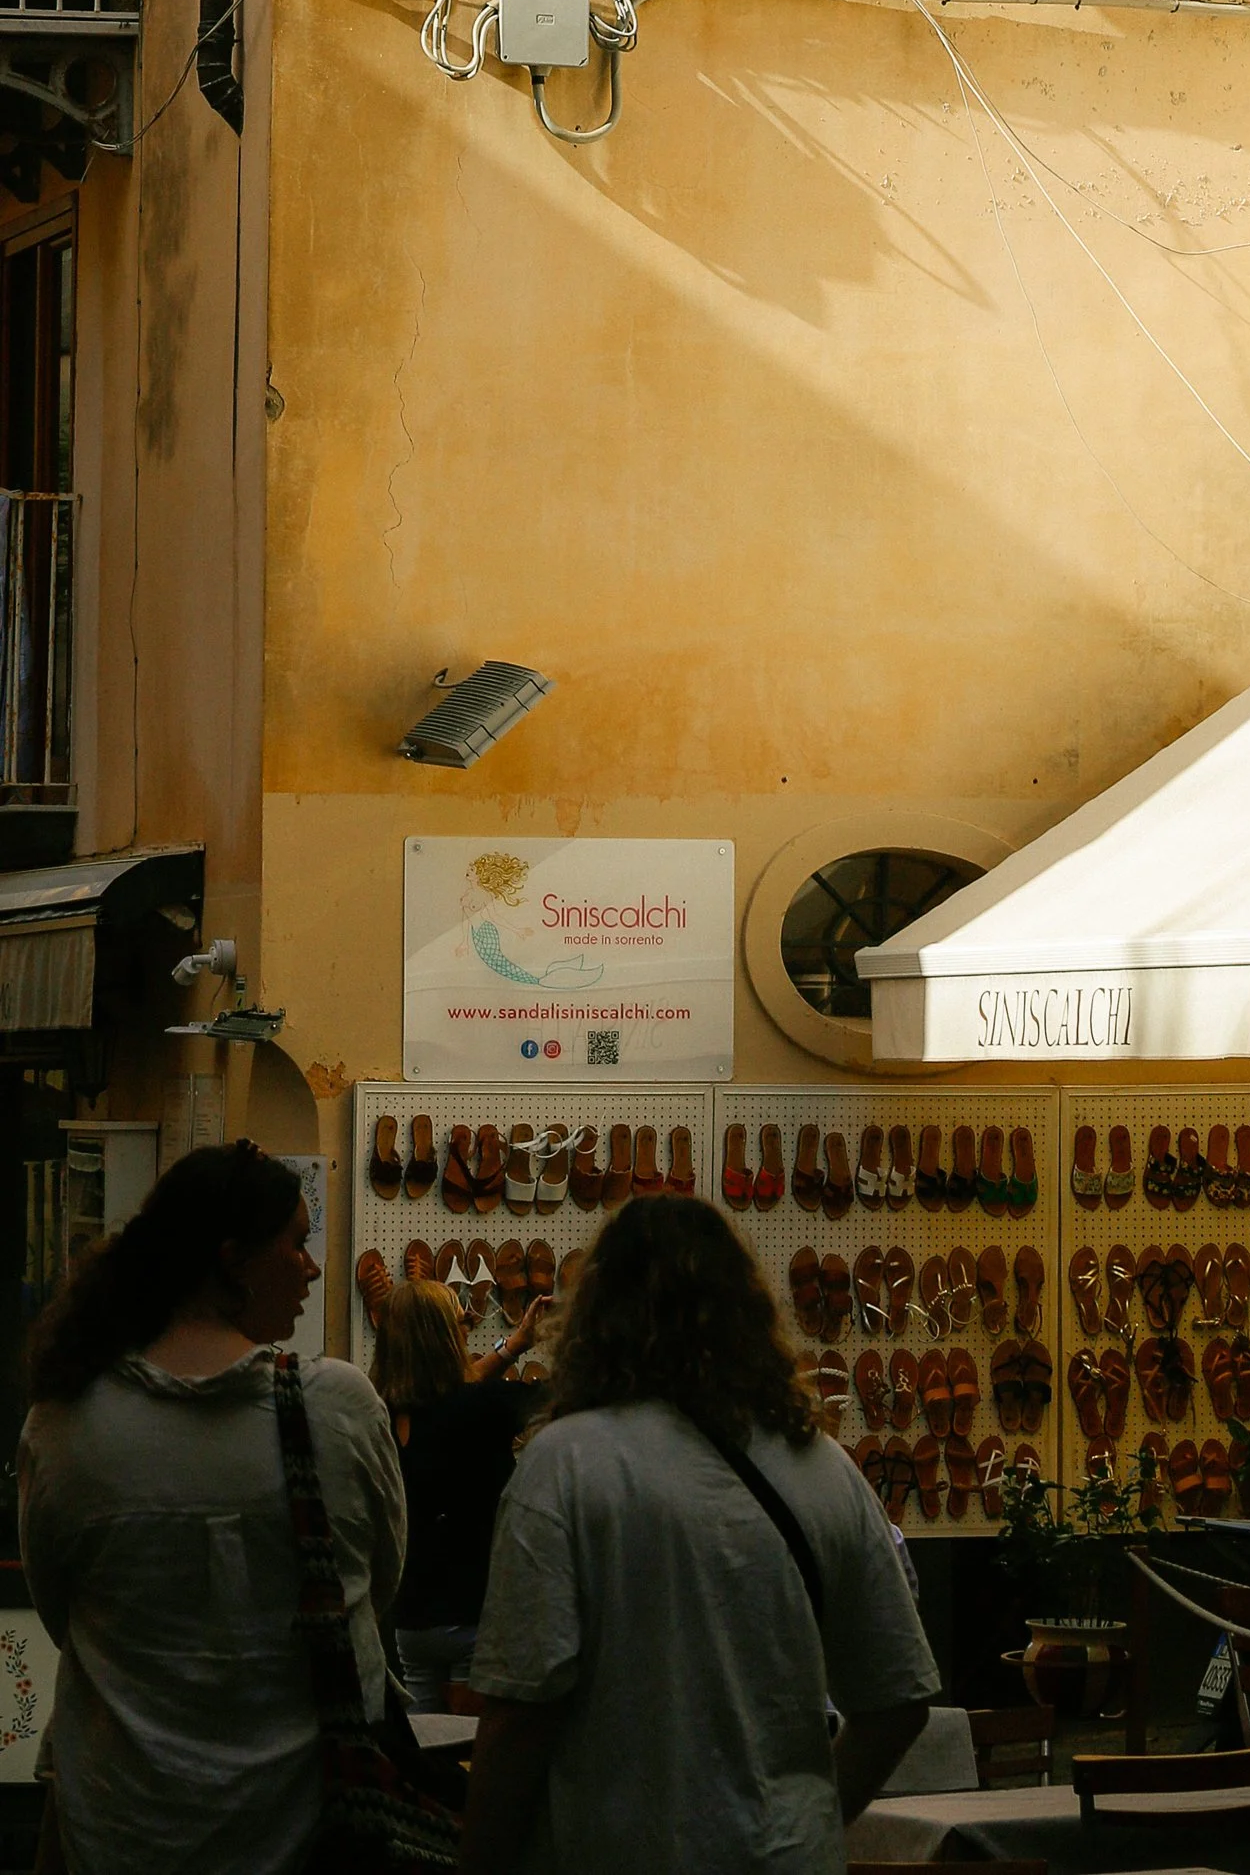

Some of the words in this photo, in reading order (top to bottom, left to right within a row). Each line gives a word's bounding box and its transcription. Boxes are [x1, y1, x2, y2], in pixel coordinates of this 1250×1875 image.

[541, 893, 687, 928] Siniscalchi
[564, 933, 598, 945] made
[601, 934, 611, 945] in
[614, 934, 664, 945] sorrento
[447, 1003, 691, 1020] www.sandalisiniscalchi.com
[978, 987, 1133, 1047] SINISCALCHI
